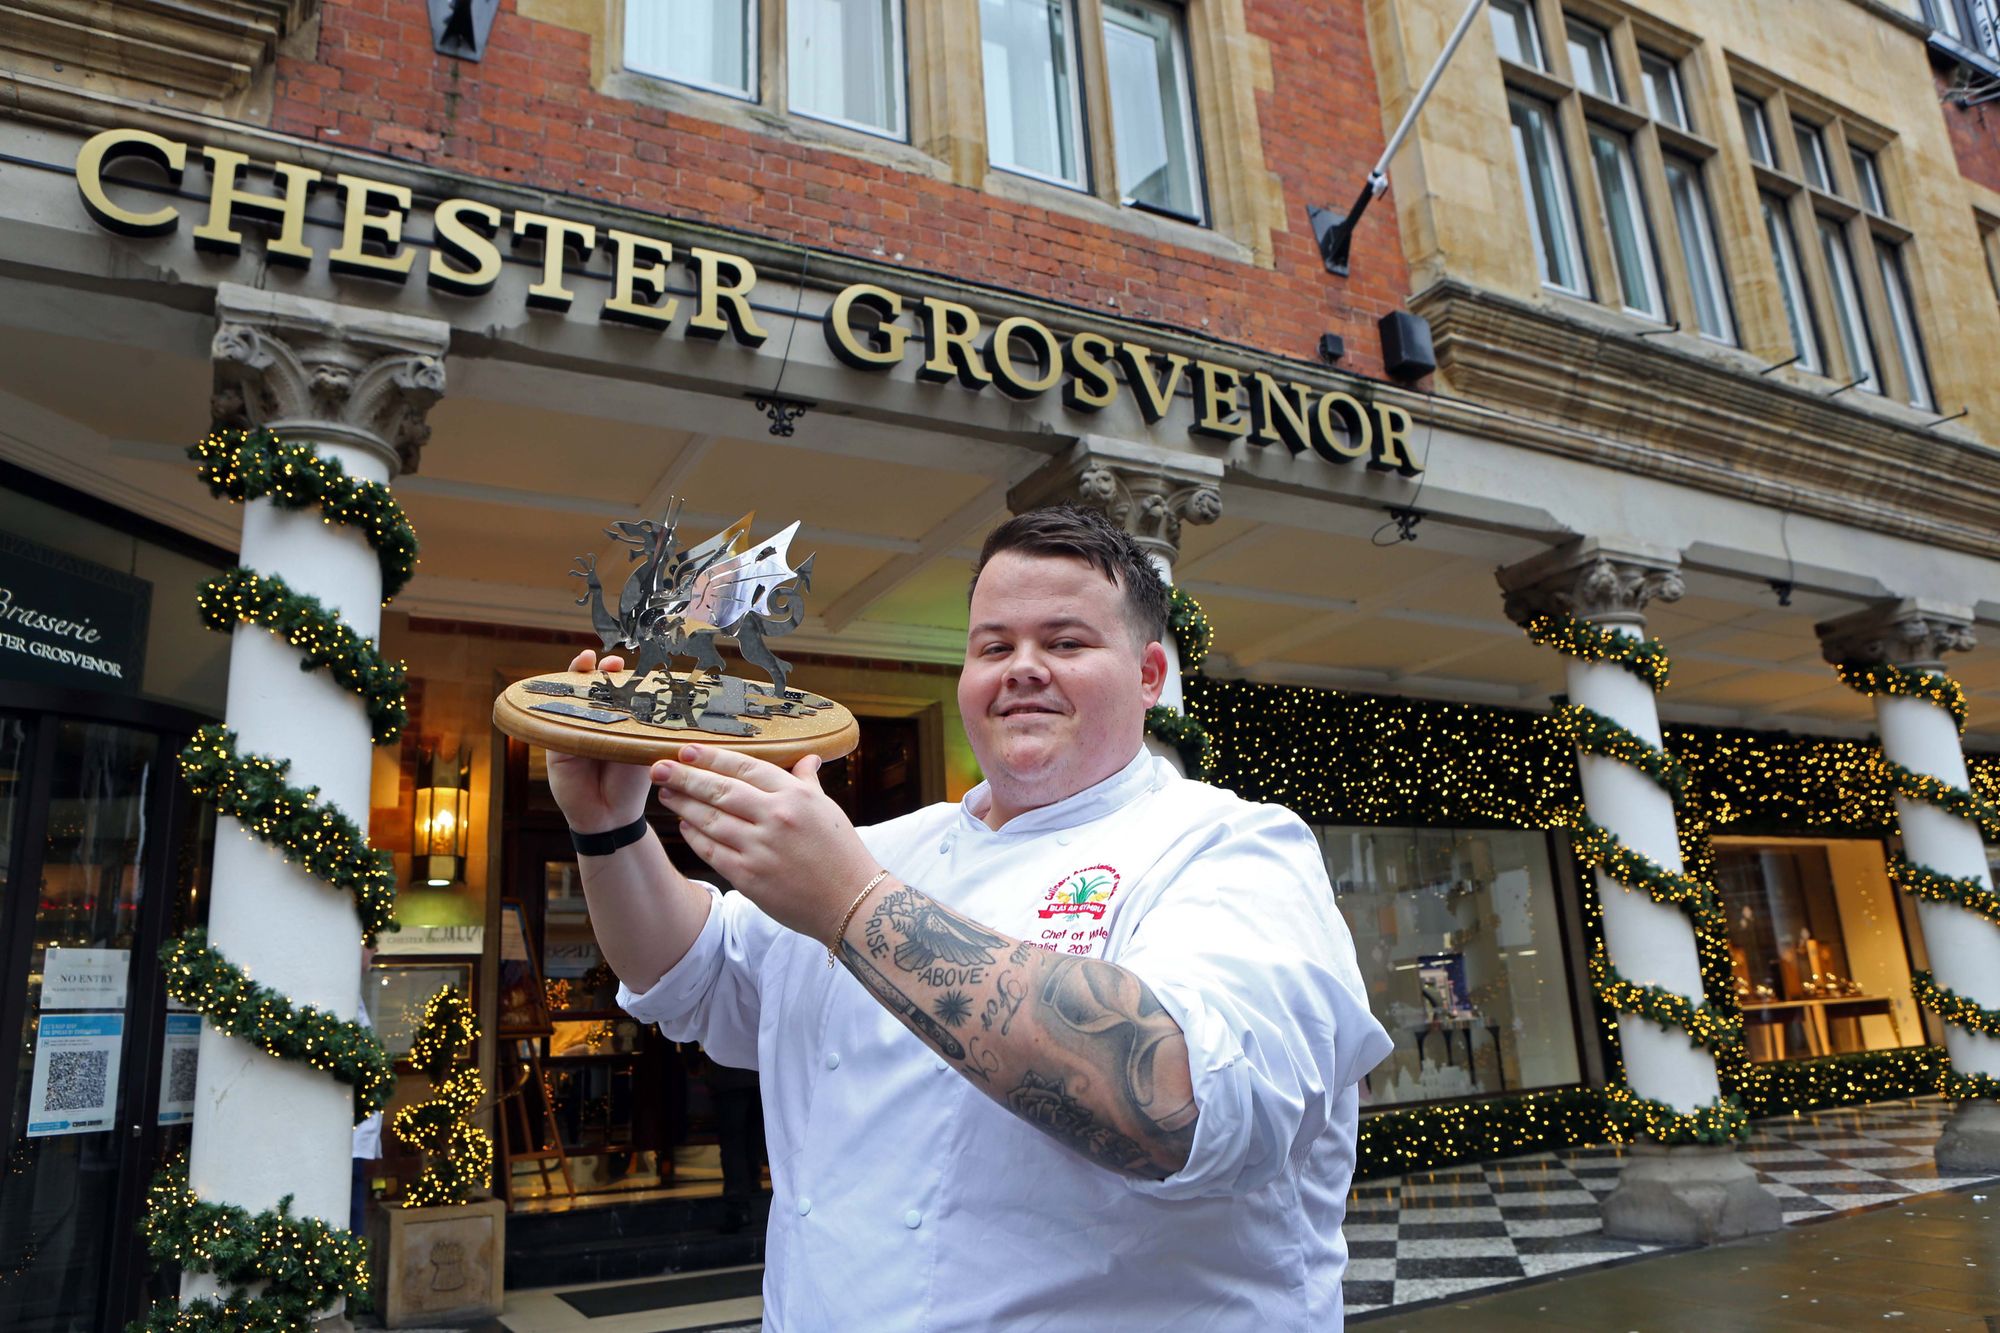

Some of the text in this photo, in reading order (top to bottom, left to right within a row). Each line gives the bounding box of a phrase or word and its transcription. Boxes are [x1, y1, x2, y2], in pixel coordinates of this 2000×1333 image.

[76, 127, 1425, 476] CHESTER GROSVENOR
[29, 641, 123, 678] GROSVENOR
[865, 918, 889, 959] RISE
[1041, 929, 1067, 939] Chef
[1071, 931, 1085, 940] of
[60, 974, 114, 983] NO ENTRY
[919, 968, 984, 987] ABOVE
